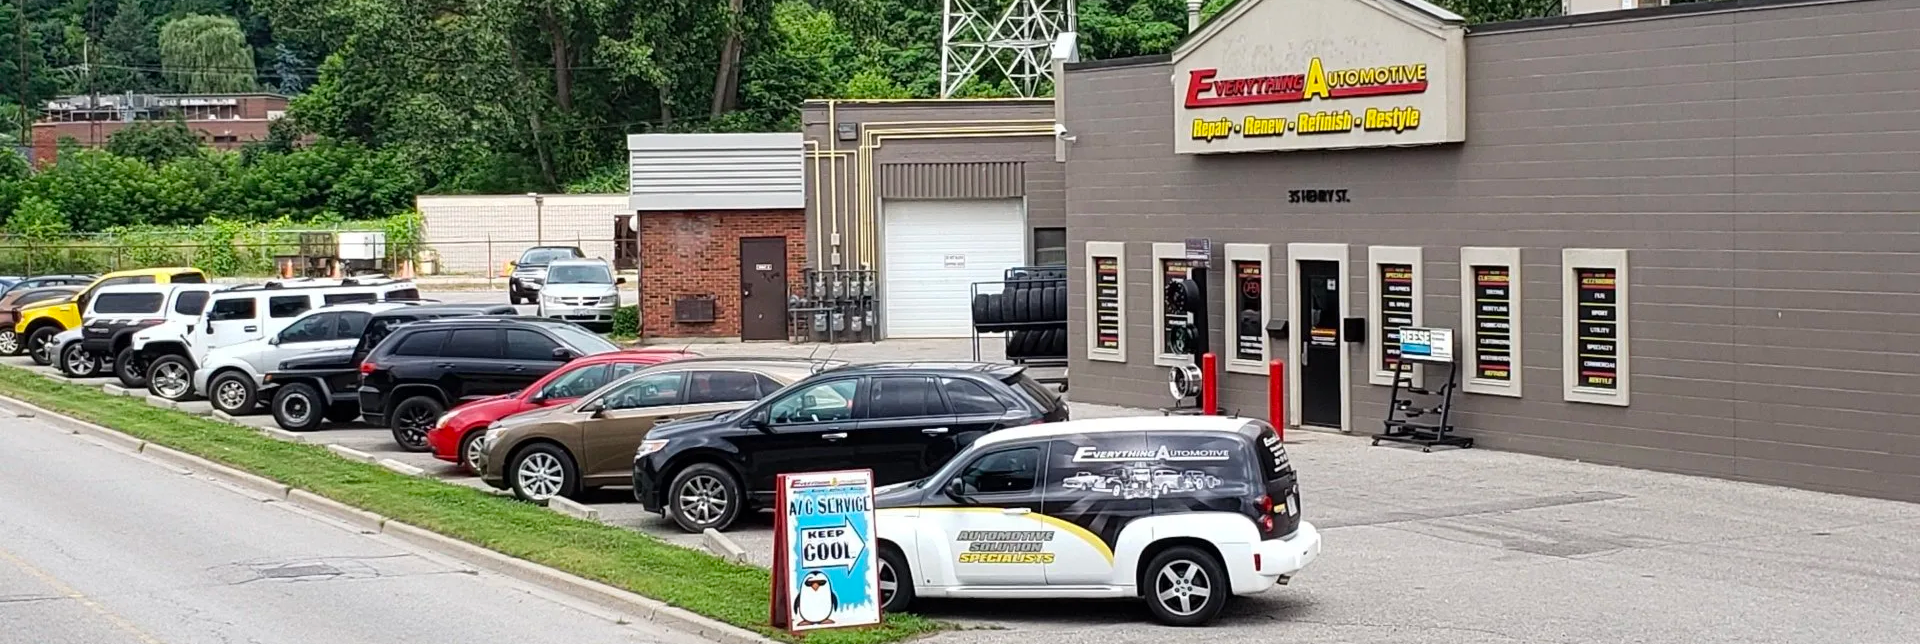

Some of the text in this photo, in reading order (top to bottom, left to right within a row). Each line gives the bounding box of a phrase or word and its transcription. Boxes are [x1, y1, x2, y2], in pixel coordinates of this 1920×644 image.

[1185, 56, 1427, 108] EVERYTHING AUTOMOTIVE
[1192, 106, 1419, 142] Repair Renew Refinish Restyle
[1400, 330, 1430, 344] REESE
[1072, 445, 1229, 463] EVERYTHING AUTOMOTIVE
[789, 495, 871, 516] A/C SERVICE
[808, 529, 845, 539] KEEP
[956, 530, 1055, 541] AUTOMOTIVE
[803, 541, 856, 562] COOL
[969, 542, 1043, 552] SOLUTION
[959, 553, 1055, 564] SPECIALISTS
